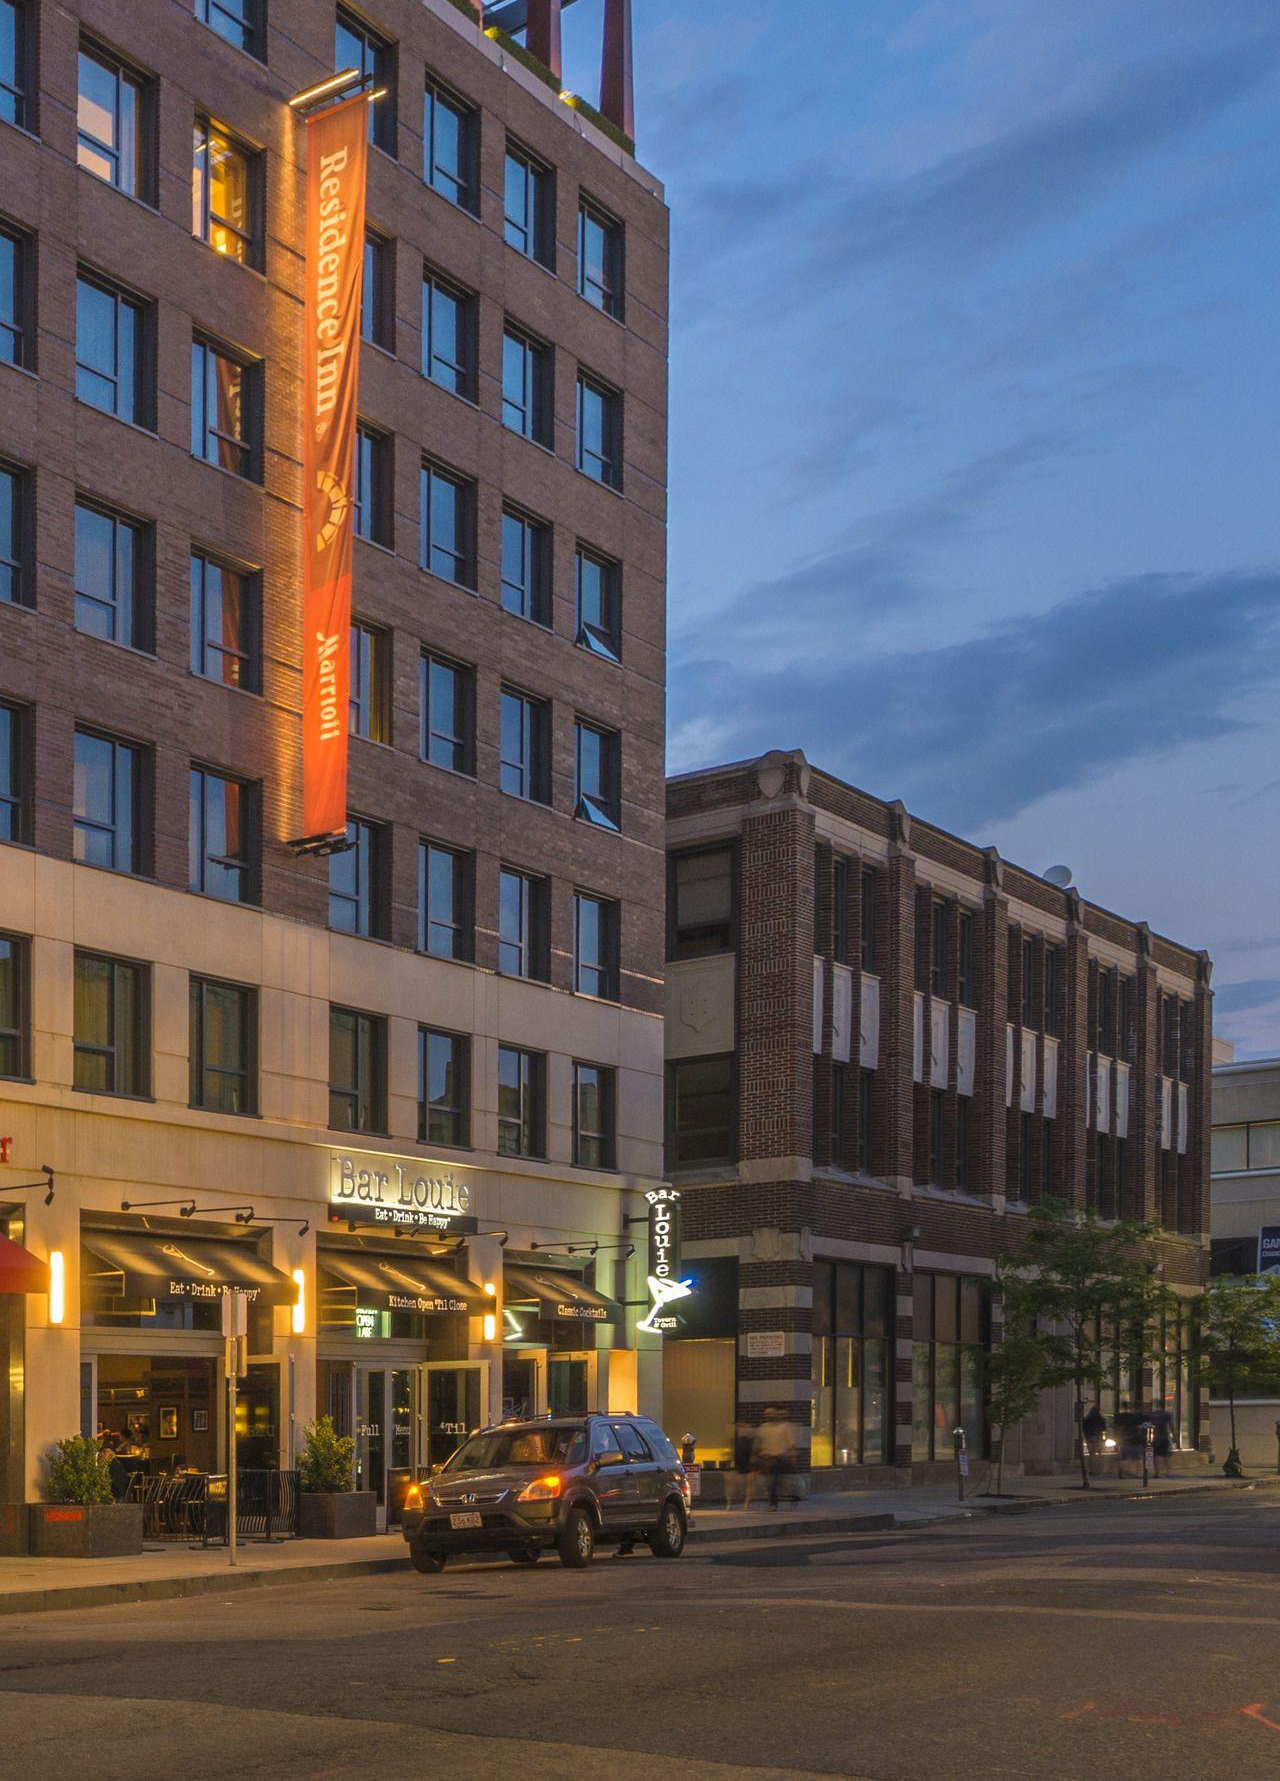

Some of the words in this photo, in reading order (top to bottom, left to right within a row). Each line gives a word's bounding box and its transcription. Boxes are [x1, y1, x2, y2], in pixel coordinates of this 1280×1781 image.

[316, 145, 348, 339] Residence
[316, 344, 345, 416] Inn
[316, 631, 341, 741] Marriott
[336, 1155, 389, 1202] Bar
[396, 1163, 469, 1213] Louie
[645, 1189, 680, 1204] Bar
[375, 1208, 388, 1220] Eat
[393, 1210, 414, 1224] Drink
[419, 1213, 427, 1225] Be
[654, 1204, 671, 1277] Louie
[170, 1281, 185, 1294] Eat
[192, 1283, 216, 1297] Drink
[389, 1295, 416, 1308] Kitchen
[417, 1298, 434, 1311] Open
[449, 1300, 467, 1311] Close
[558, 1305, 578, 1317] Classic
[580, 1307, 607, 1319] Cocktails
[361, 1424, 379, 1436] Full
